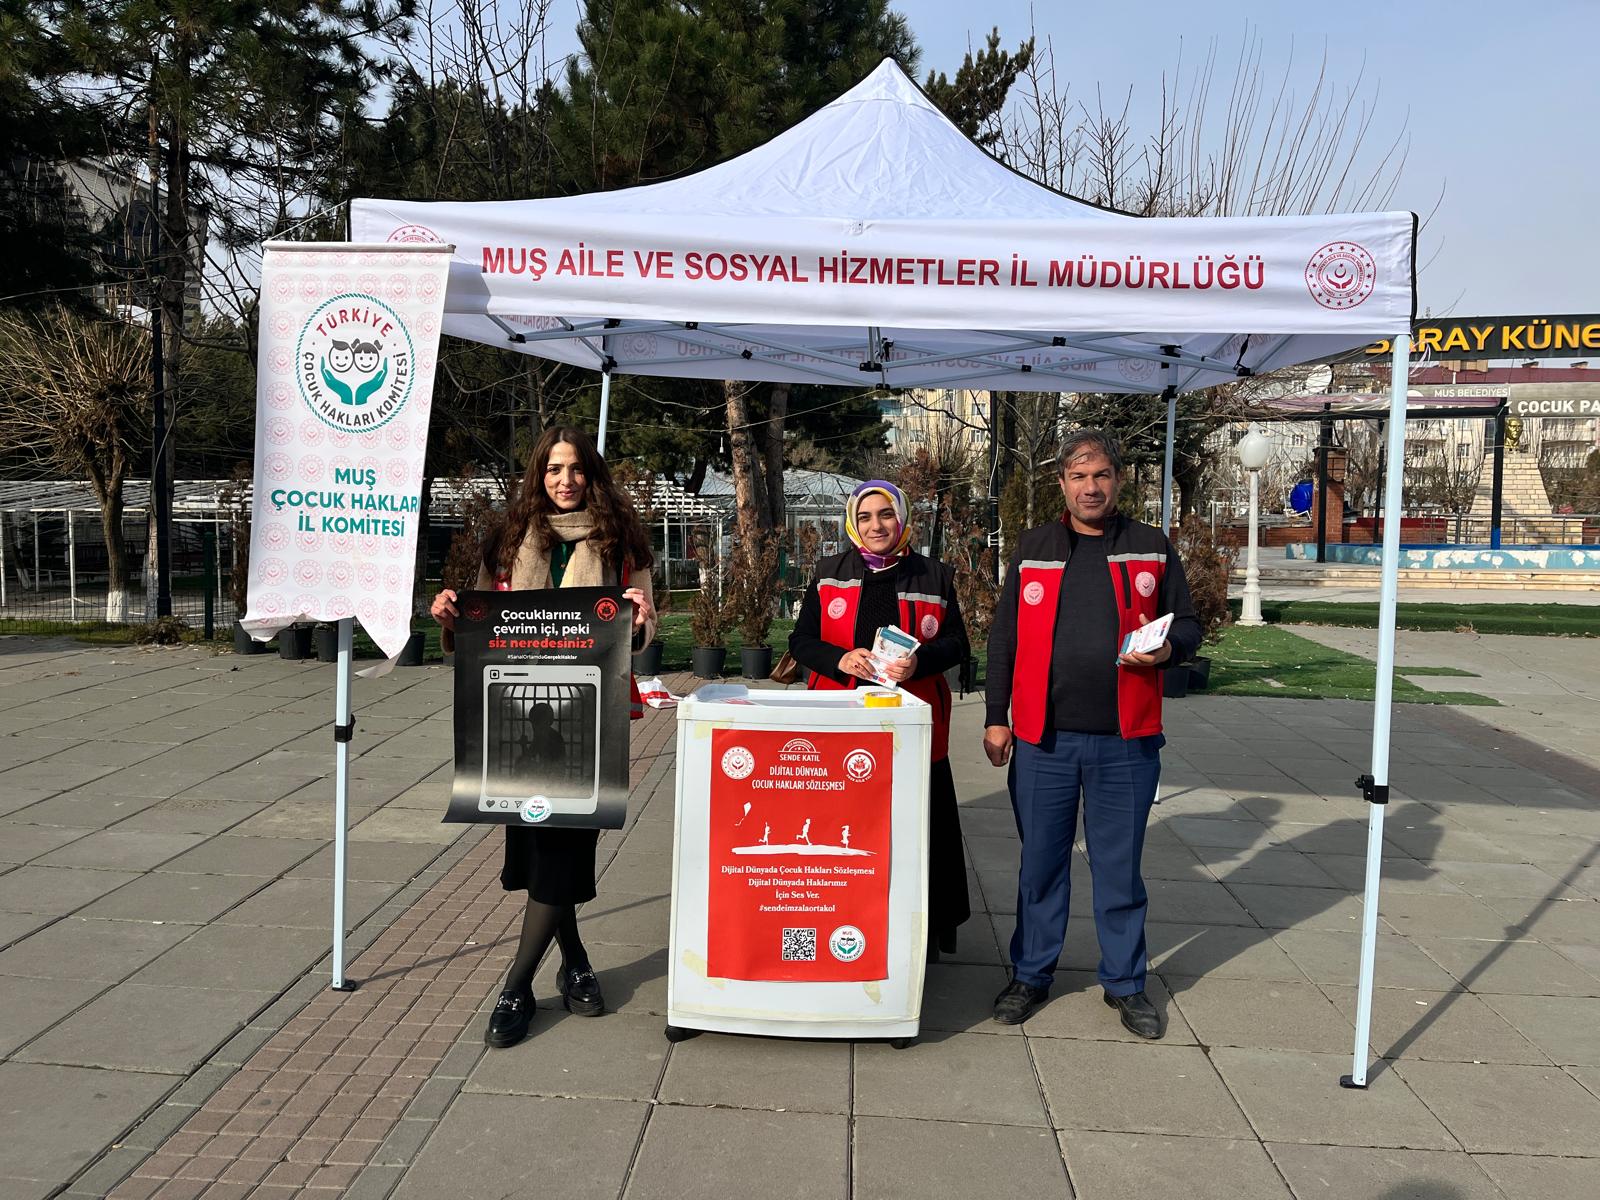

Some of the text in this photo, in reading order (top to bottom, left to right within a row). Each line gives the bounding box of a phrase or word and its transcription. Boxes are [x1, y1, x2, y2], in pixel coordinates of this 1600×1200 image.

[482, 242, 1265, 290] MUŞ AİLE VE SOSYAL HİZMETLER İL MÜDÜRLÜĞÜ
[316, 306, 394, 337] TÜRKİYE
[1365, 327, 1495, 354] RAY
[302, 351, 408, 426] ÇOCUK HAKLARI KOMİTESİ
[1517, 400, 1574, 416] ÇOCUK
[335, 467, 376, 491] MUŞ
[271, 489, 345, 511] ÇOCUK
[298, 510, 404, 537] İL KOMİTESİ
[501, 609, 581, 622] Çocuklarınız
[493, 623, 590, 637] çevrim içi, peki
[489, 636, 594, 648] siz neredesiniz?
[802, 754, 820, 762] KATIL
[795, 766, 828, 777] DÜNYADA
[752, 779, 845, 791] ÇOCUK HAKLARI SÖZLEŞMESİ
[721, 866, 875, 876] Dijital Dünyada Çocuk Hakları Sözleşmesi
[748, 878, 847, 888] Dijital Dünyada Haklarımız
[775, 889, 820, 900] İçin Ses Ver.
[759, 904, 835, 912] #sendeimzalaortakol
